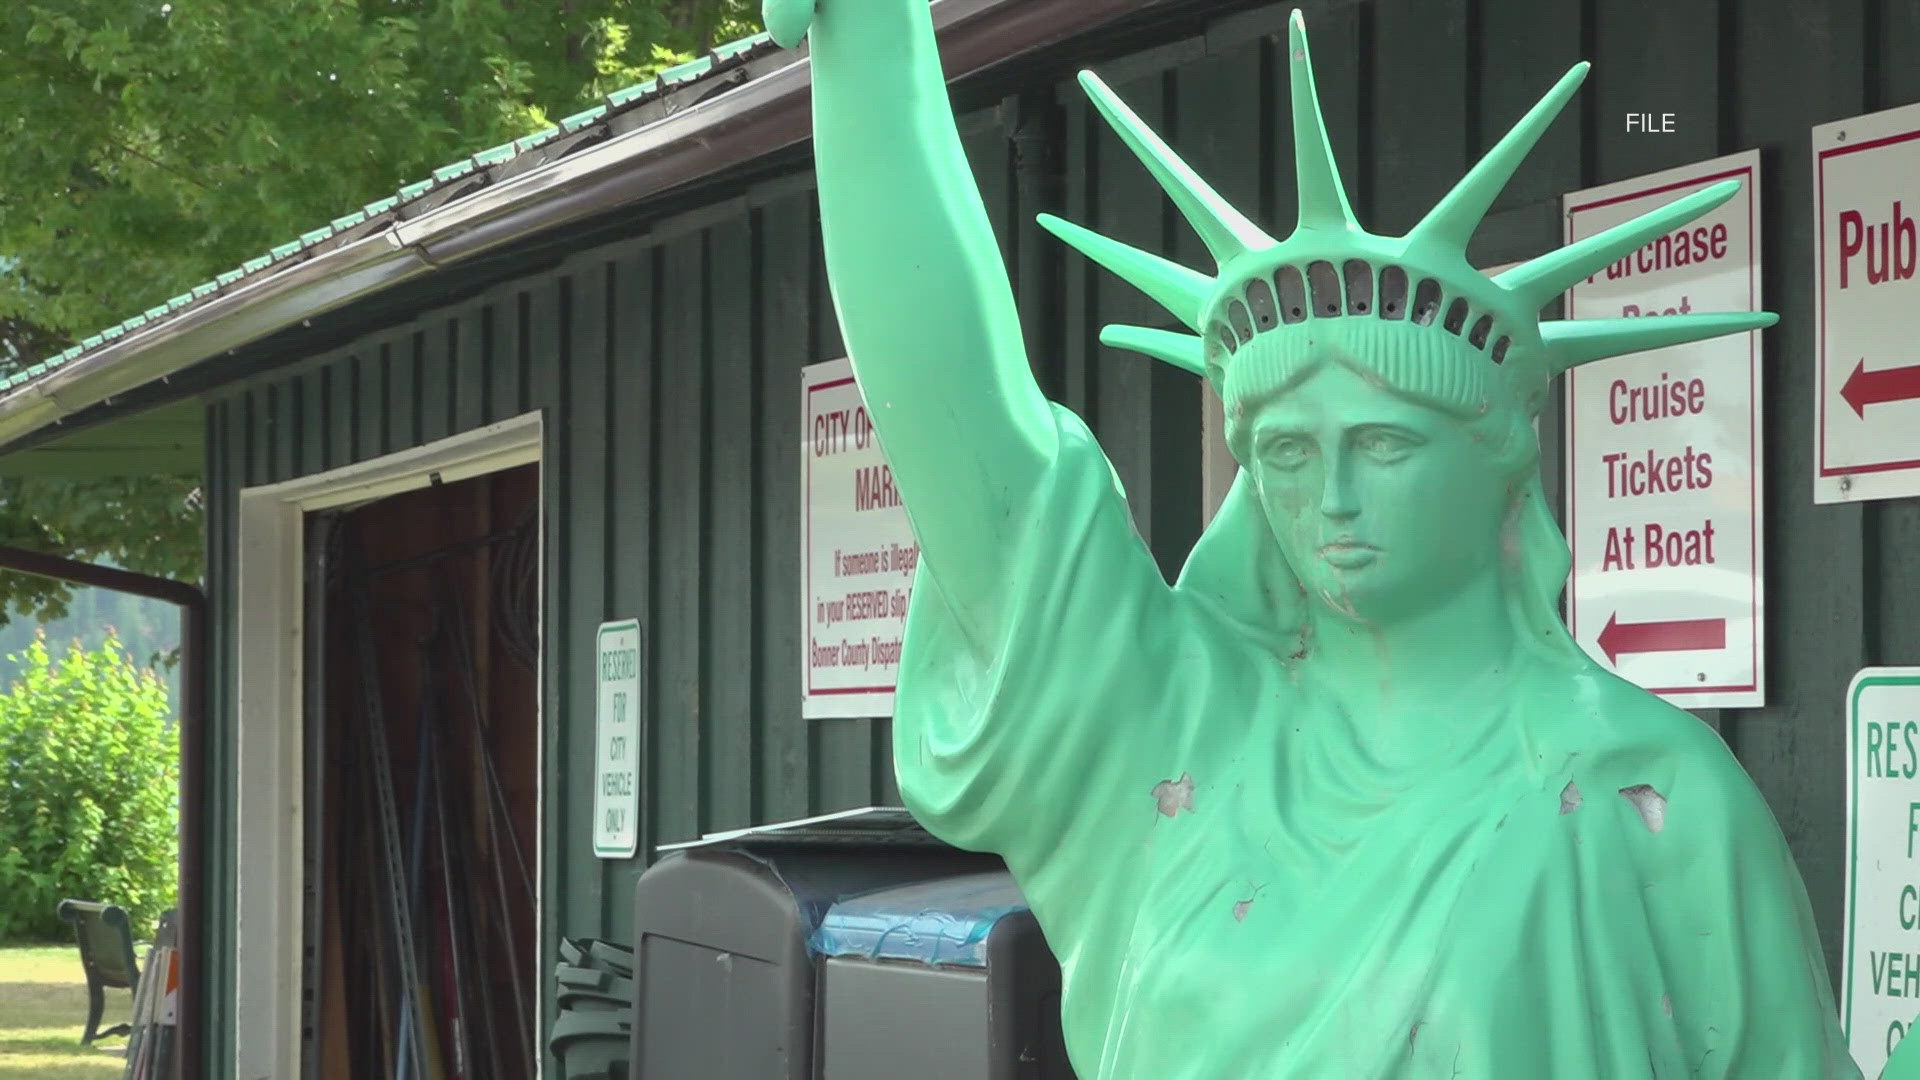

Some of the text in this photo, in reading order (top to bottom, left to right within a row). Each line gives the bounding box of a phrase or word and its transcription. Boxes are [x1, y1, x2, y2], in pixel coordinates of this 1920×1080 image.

[1587, 222, 1728, 284] uchase
[1840, 200, 1917, 289] Pub
[1609, 372, 1705, 425] Cruise
[815, 410, 850, 457] CITY
[1602, 445, 1713, 499] Tickets
[834, 549, 841, 577] If
[843, 551, 879, 576] someone
[881, 544, 889, 572] is
[1602, 519, 1715, 572] At Boat
[817, 597, 825, 623] in
[826, 601, 844, 629] your
[846, 590, 888, 620] RESERVED
[891, 589, 906, 623] slip
[602, 648, 636, 682] RESERVED
[811, 637, 840, 668] Bonner
[841, 638, 869, 671] County
[613, 691, 626, 723] FOR
[610, 735, 626, 760] CITY
[1867, 720, 1919, 779] RES
[602, 771, 632, 796] VEHICLE
[606, 808, 626, 832] ONLY
[1870, 951, 1920, 998] VEH
